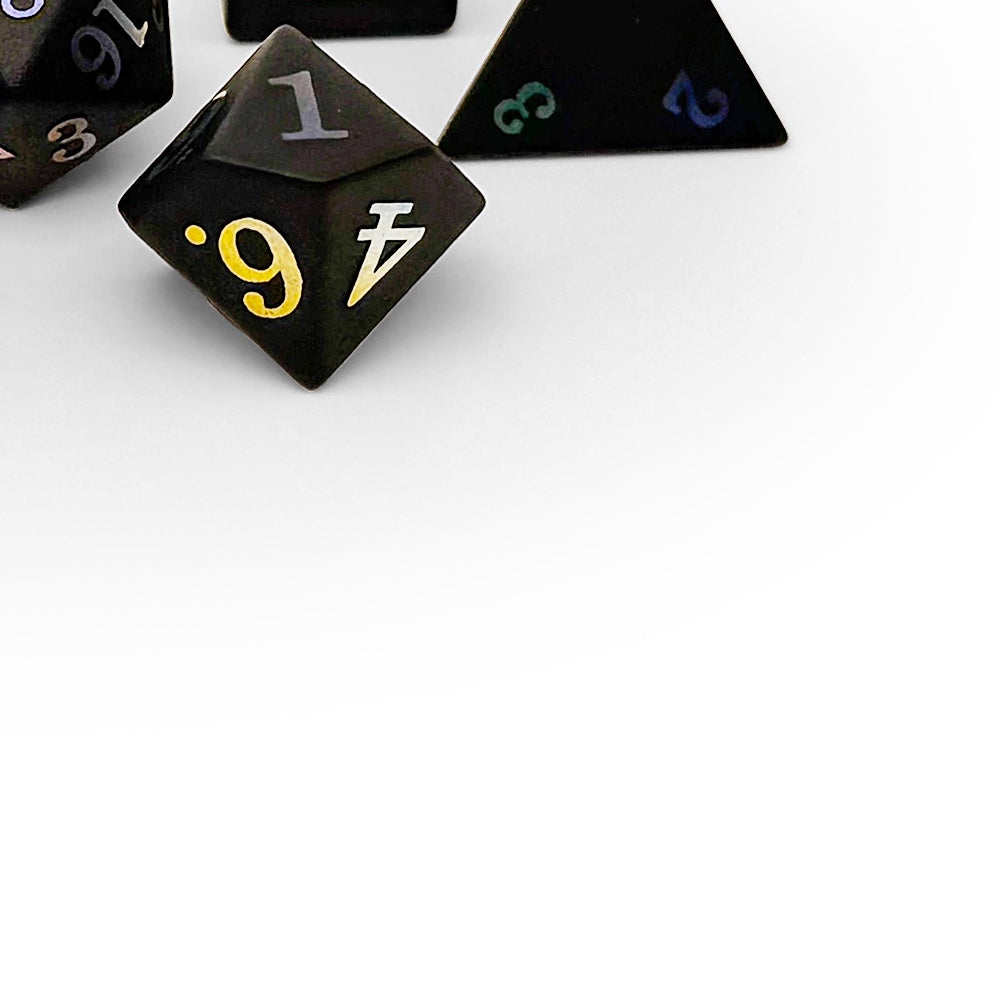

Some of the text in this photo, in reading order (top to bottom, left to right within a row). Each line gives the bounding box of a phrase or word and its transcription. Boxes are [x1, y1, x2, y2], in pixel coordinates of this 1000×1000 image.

[266, 70, 350, 141] 1
[493, 80, 557, 136] 3
[661, 66, 730, 130] 2
[47, 117, 98, 163] 3
[346, 201, 428, 308] 4
